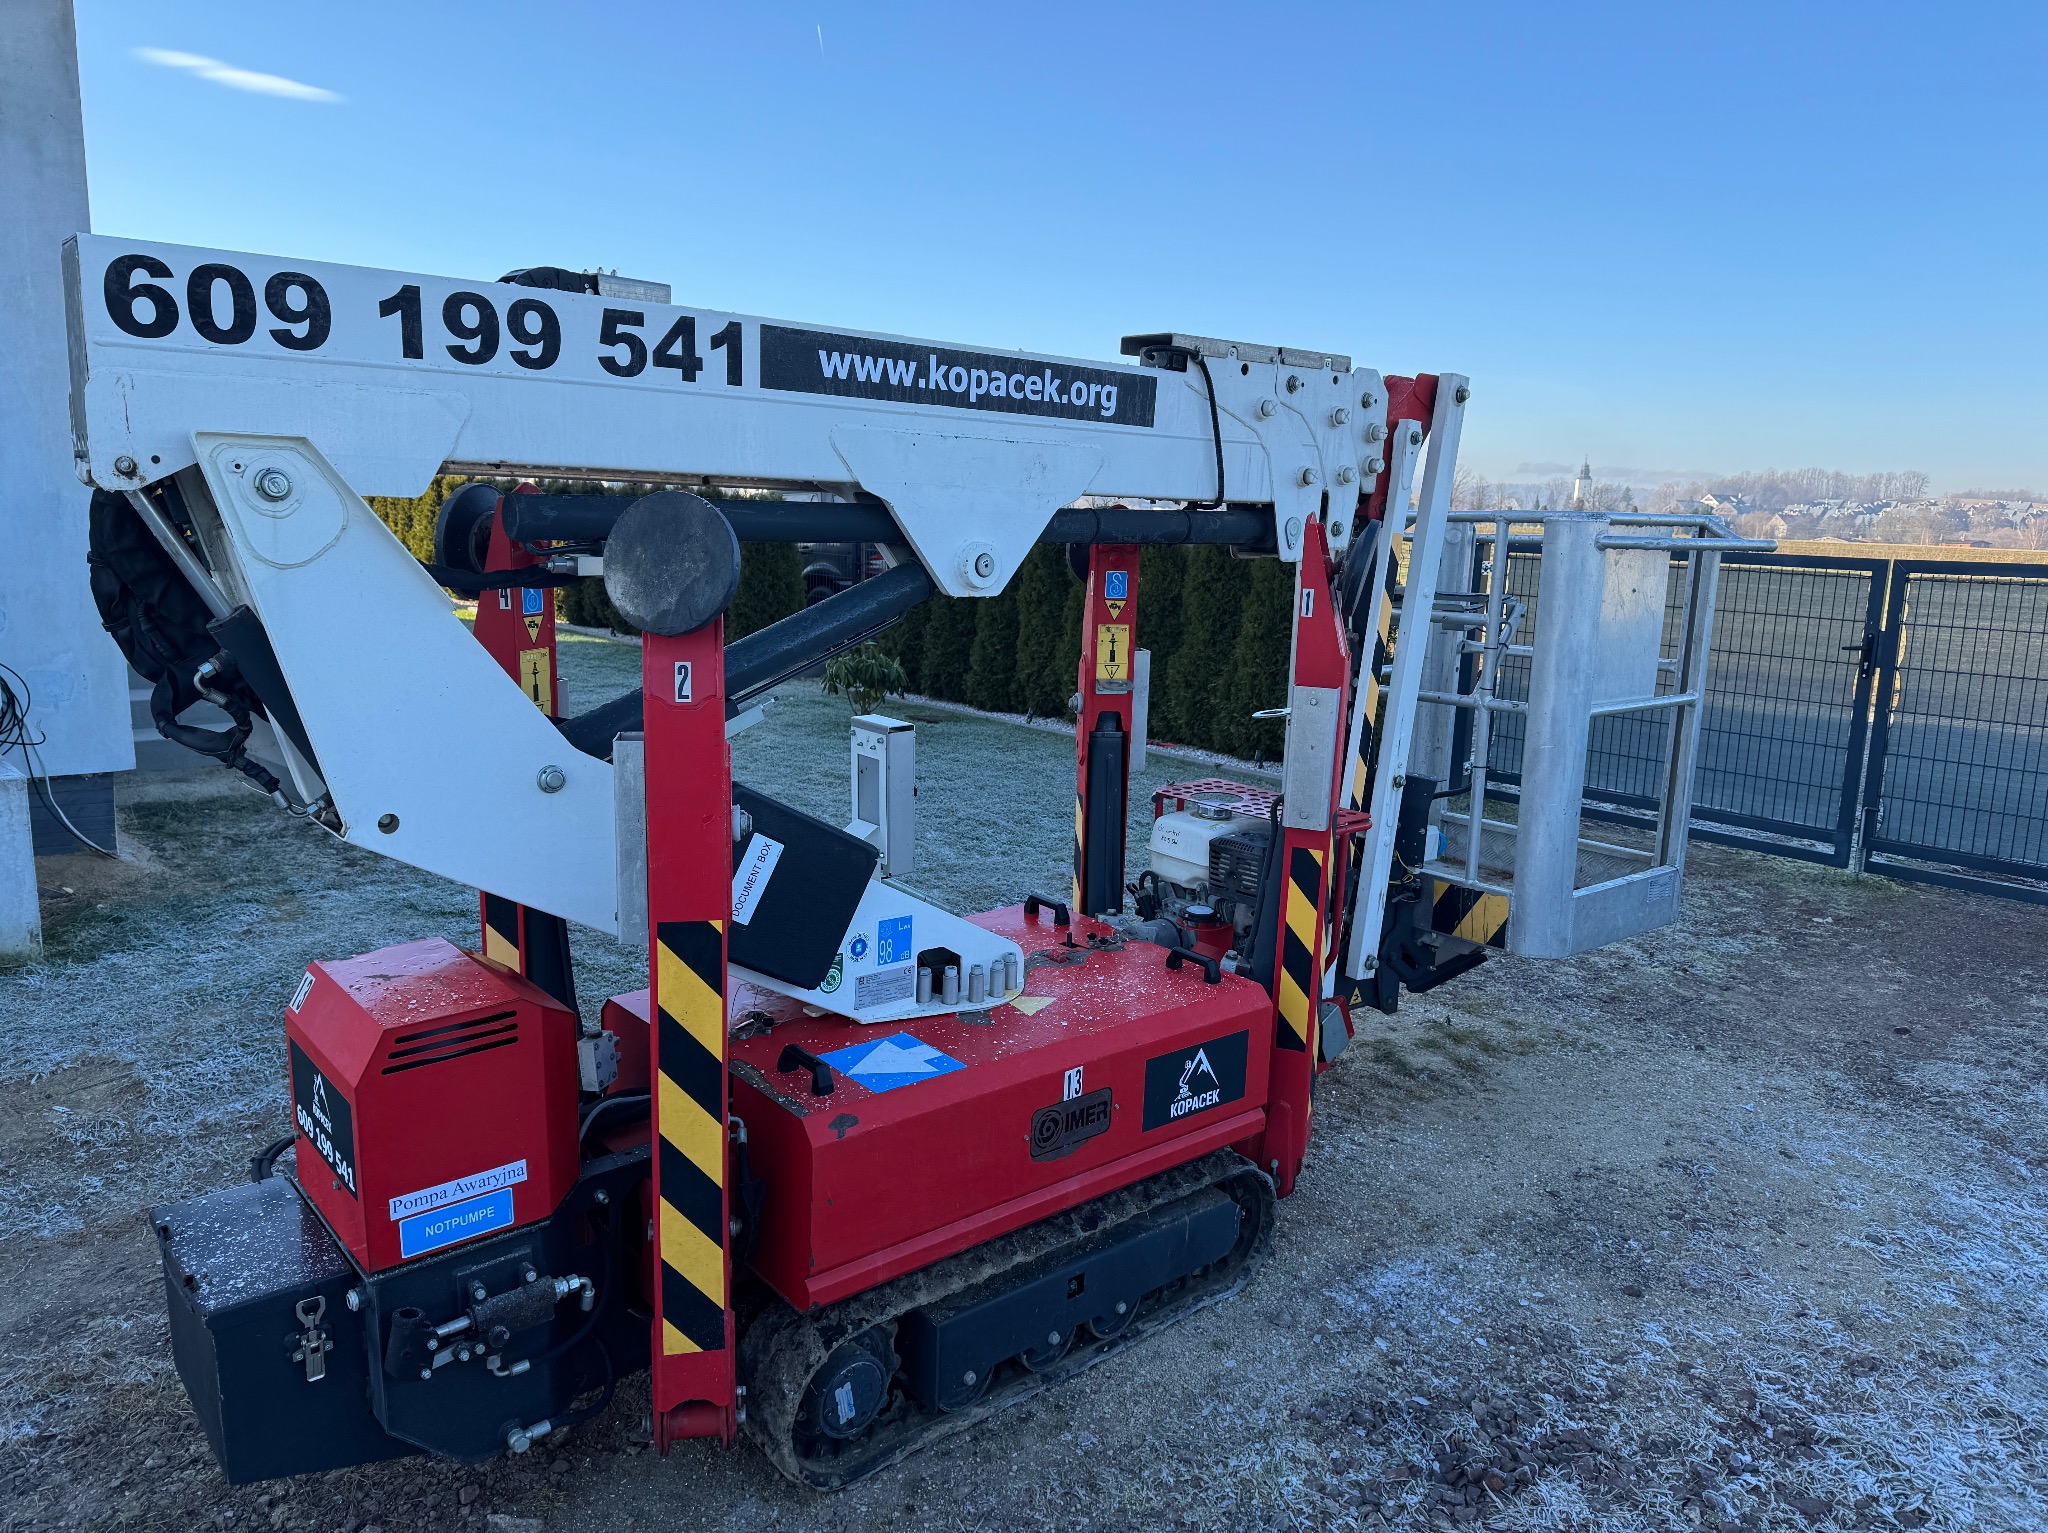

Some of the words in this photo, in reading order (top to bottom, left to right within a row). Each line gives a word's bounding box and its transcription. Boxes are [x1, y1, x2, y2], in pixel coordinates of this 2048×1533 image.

[103, 253, 332, 351] 609
[378, 284, 562, 371] 199
[597, 308, 743, 387] 541
[818, 349, 1118, 417] www.kopacek.org
[677, 664, 690, 700] 2
[732, 863, 762, 917] DOCUMENT
[757, 841, 773, 863] BOX
[879, 938, 893, 964] 98
[1064, 1100, 1109, 1133] IMER
[1170, 1088, 1220, 1119] KOPACEK
[296, 1103, 314, 1139] 609
[315, 1127, 334, 1164] 199
[335, 1149, 356, 1193] 541
[392, 1189, 448, 1214] Pompa
[452, 1166, 525, 1196] Awaryjna
[425, 1206, 495, 1238] NOTPUMPE
